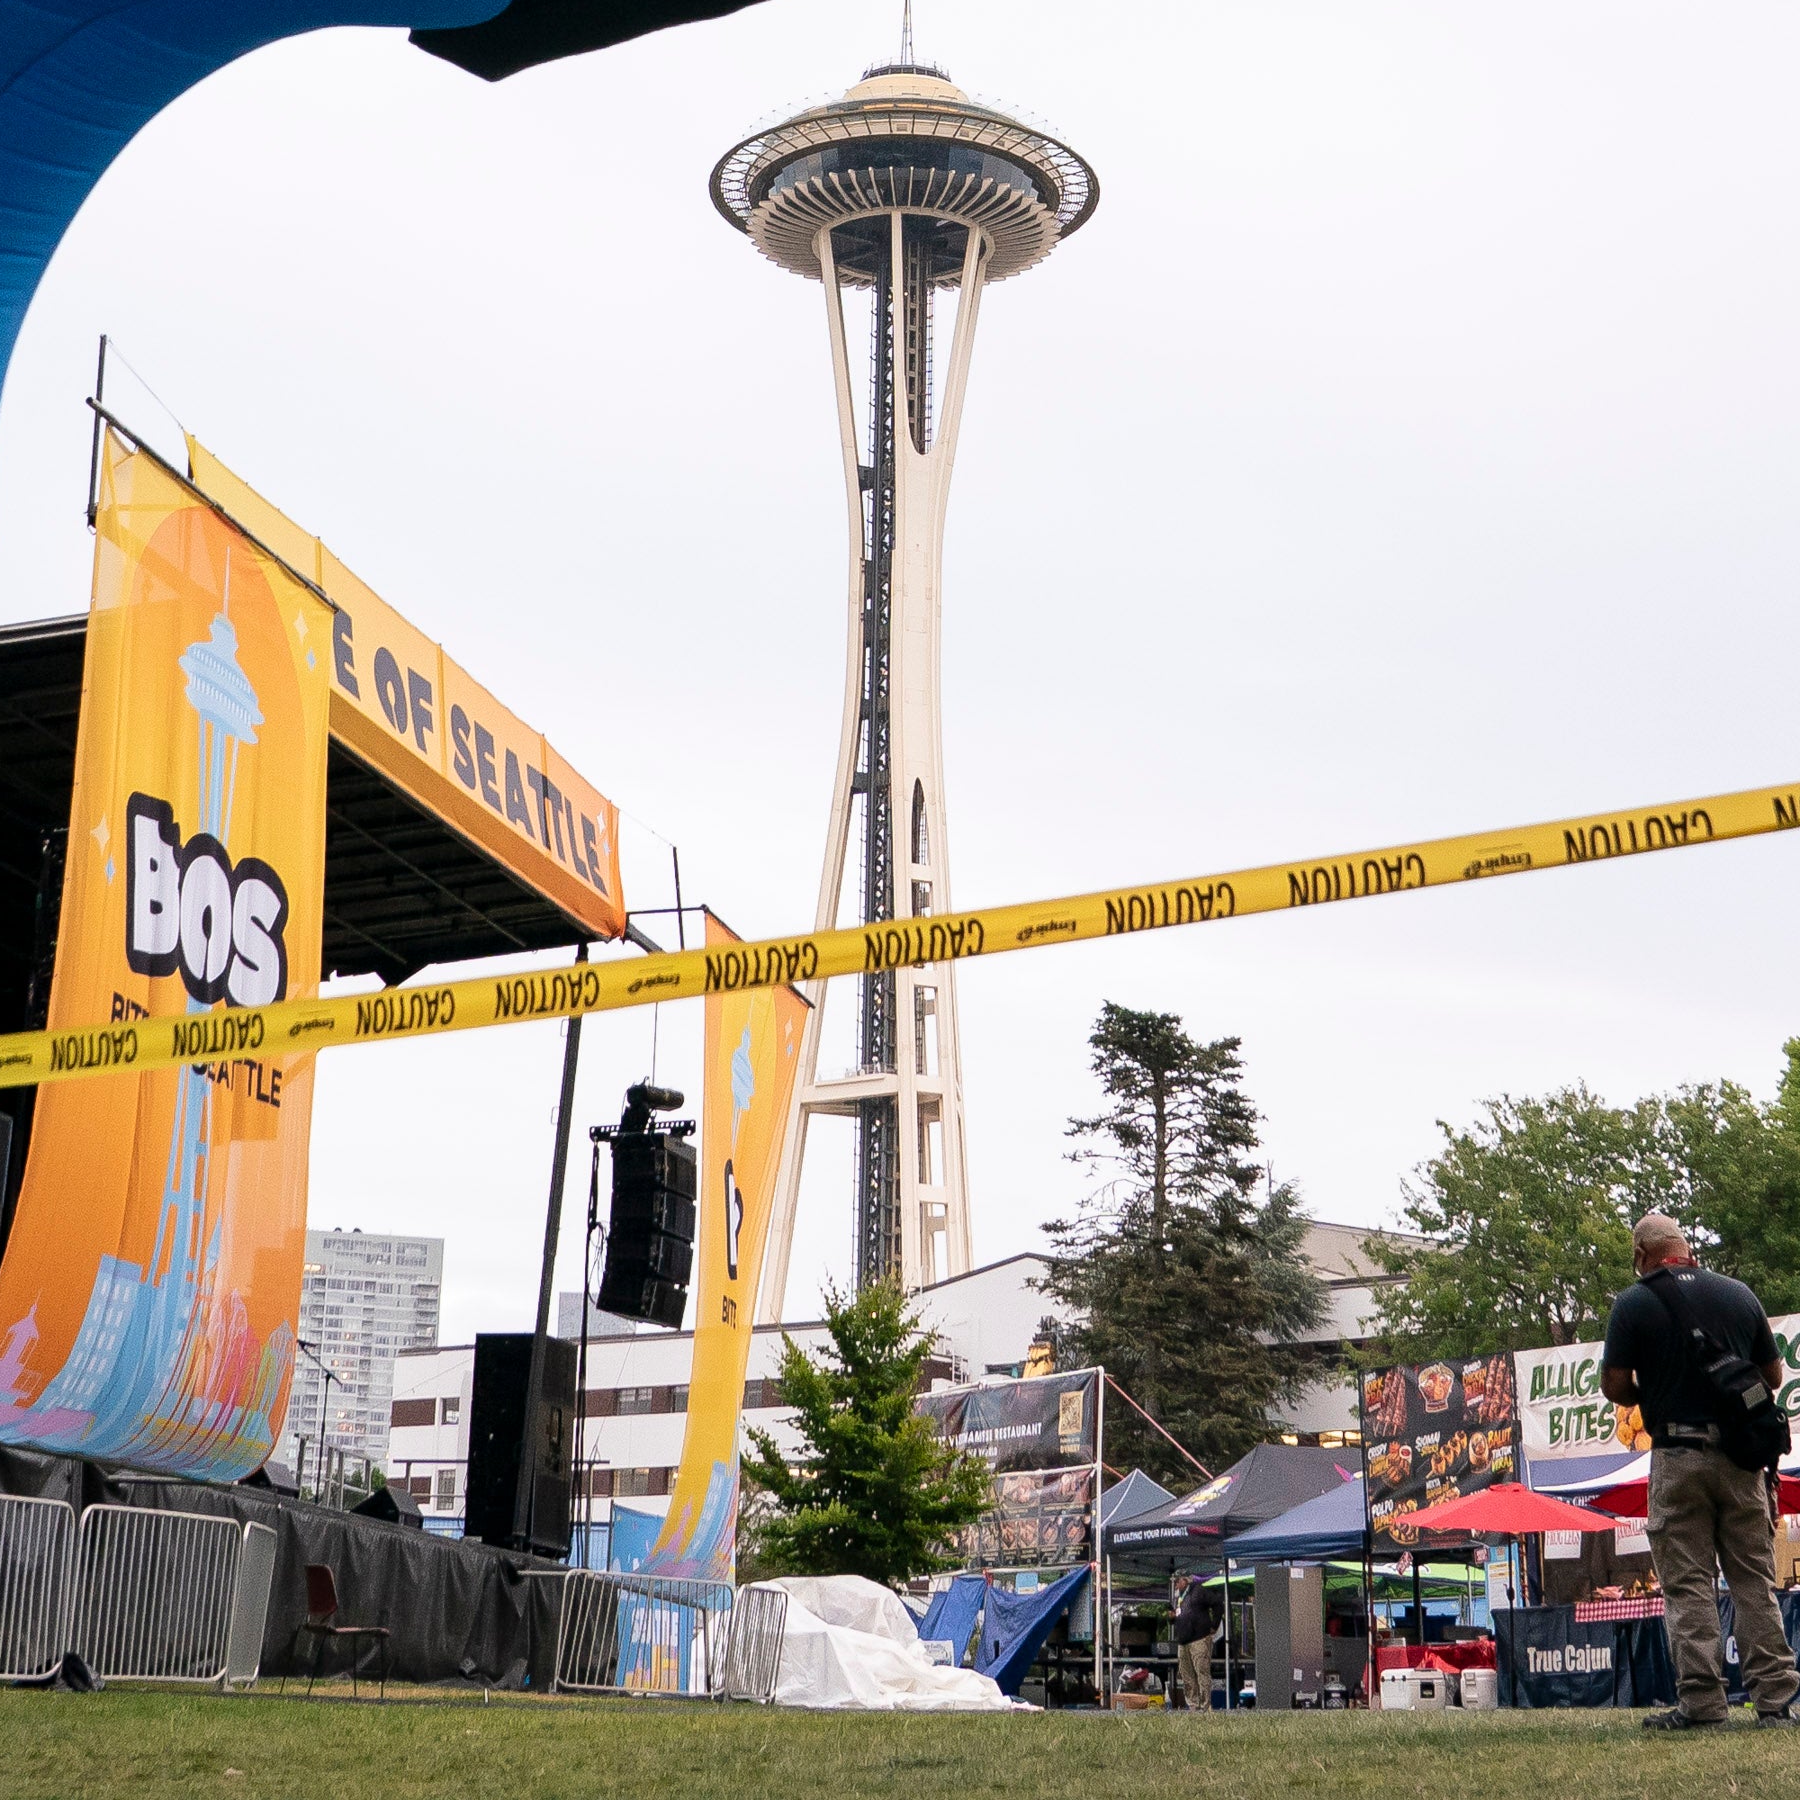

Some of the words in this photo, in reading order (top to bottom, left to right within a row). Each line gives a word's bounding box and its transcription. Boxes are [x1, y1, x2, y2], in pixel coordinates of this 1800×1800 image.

[374, 647, 433, 754] OF
[451, 704, 608, 897] SEATTLE
[1563, 809, 1714, 863] CAUTION
[129, 800, 286, 1006] BOS
[1287, 852, 1426, 907] CAUTION
[1104, 880, 1235, 935] CAUTION
[704, 940, 819, 992] CAUTION
[865, 918, 984, 970] CAUTION
[356, 987, 456, 1036] CAUTION
[494, 970, 600, 1018] CAUTION
[50, 1028, 138, 1072] CAUTION
[172, 1013, 265, 1058] CAUTION
[995, 1422, 1042, 1441] RESTAURANT
[1488, 1427, 1512, 1447] BALUT
[1550, 1402, 1614, 1445] BITES
[1372, 1499, 1393, 1517] POLPO
[1114, 1531, 1142, 1544] ELEVATING
[1144, 1529, 1159, 1540] YOUR
[1161, 1527, 1188, 1537] FAVORITE
[1527, 1646, 1562, 1673] True
[1565, 1644, 1612, 1673] Cajun
